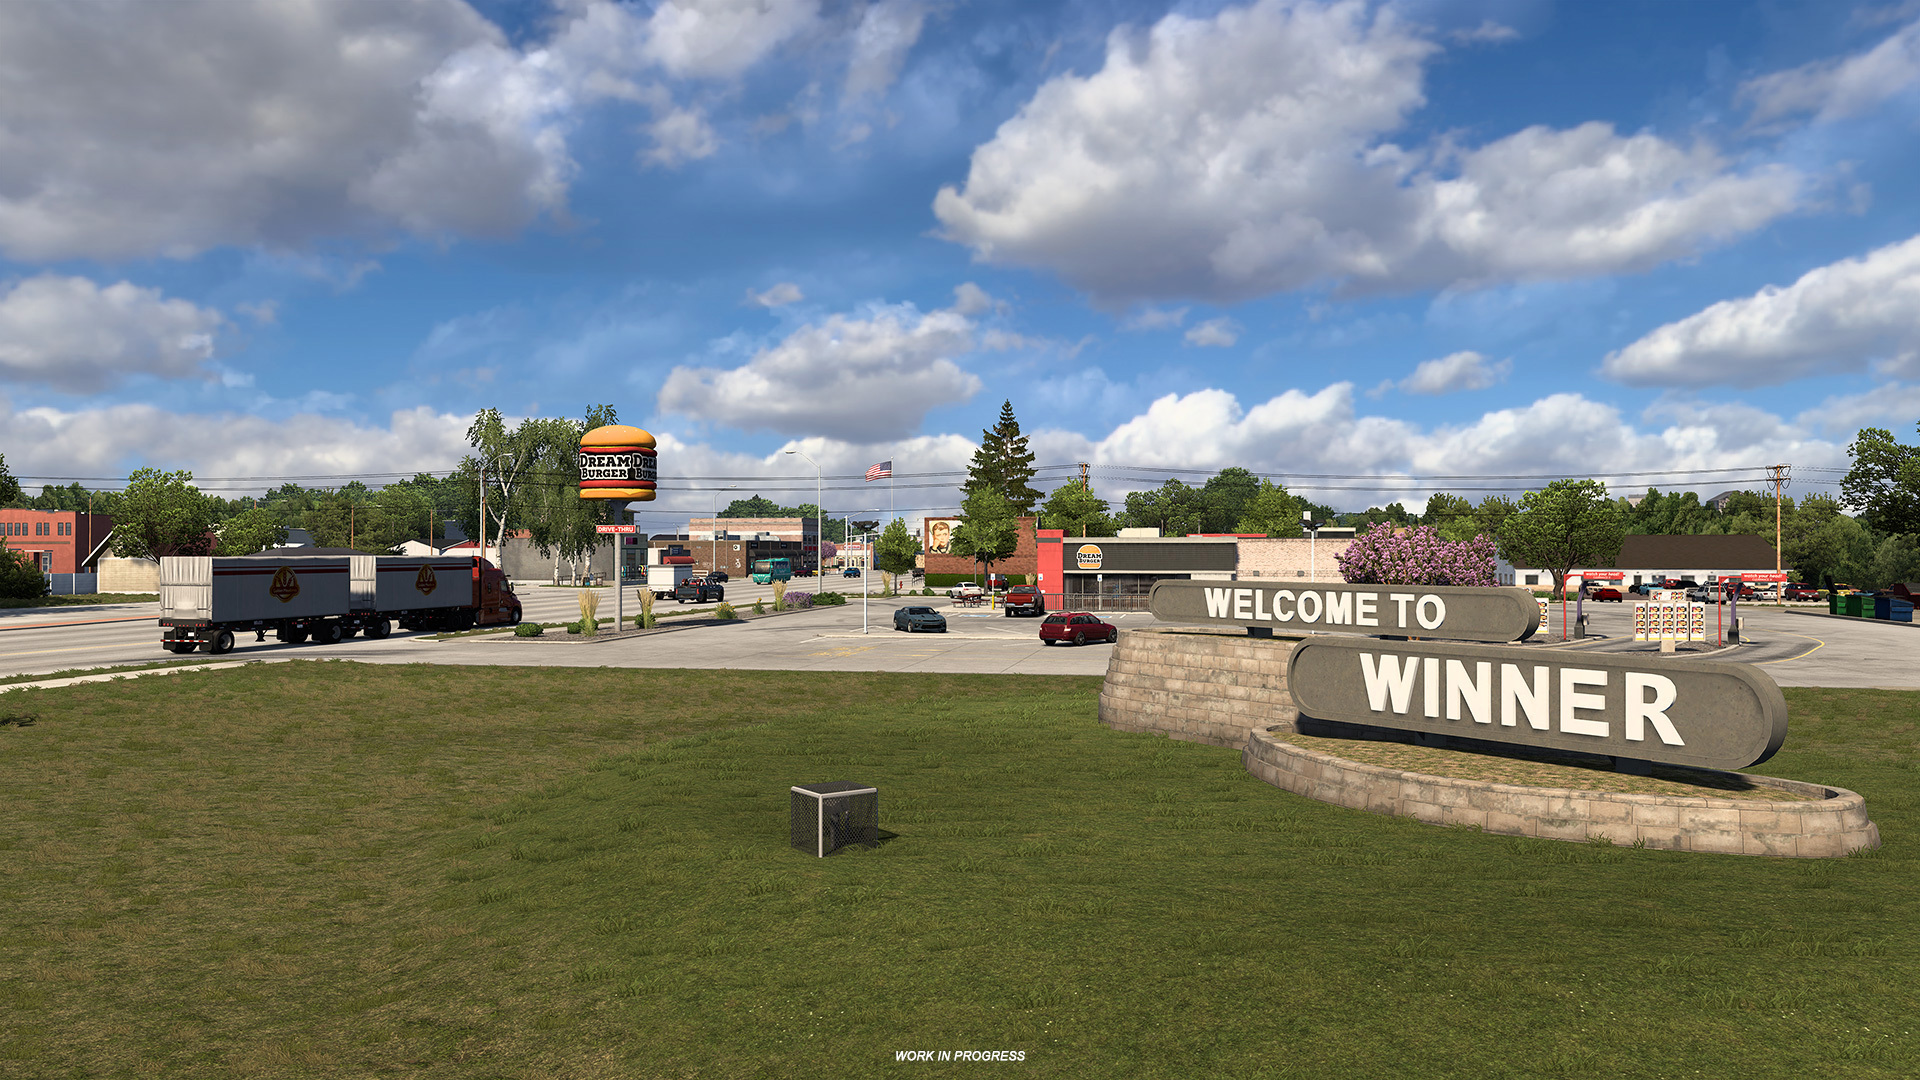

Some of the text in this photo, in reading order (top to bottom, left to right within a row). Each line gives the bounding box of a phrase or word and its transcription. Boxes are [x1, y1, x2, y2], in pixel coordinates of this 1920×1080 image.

[580, 454, 631, 468] DREAM
[581, 468, 628, 478] BURGER
[1204, 588, 1446, 630] WELCOME TO
[1359, 652, 1685, 746] WINNER
